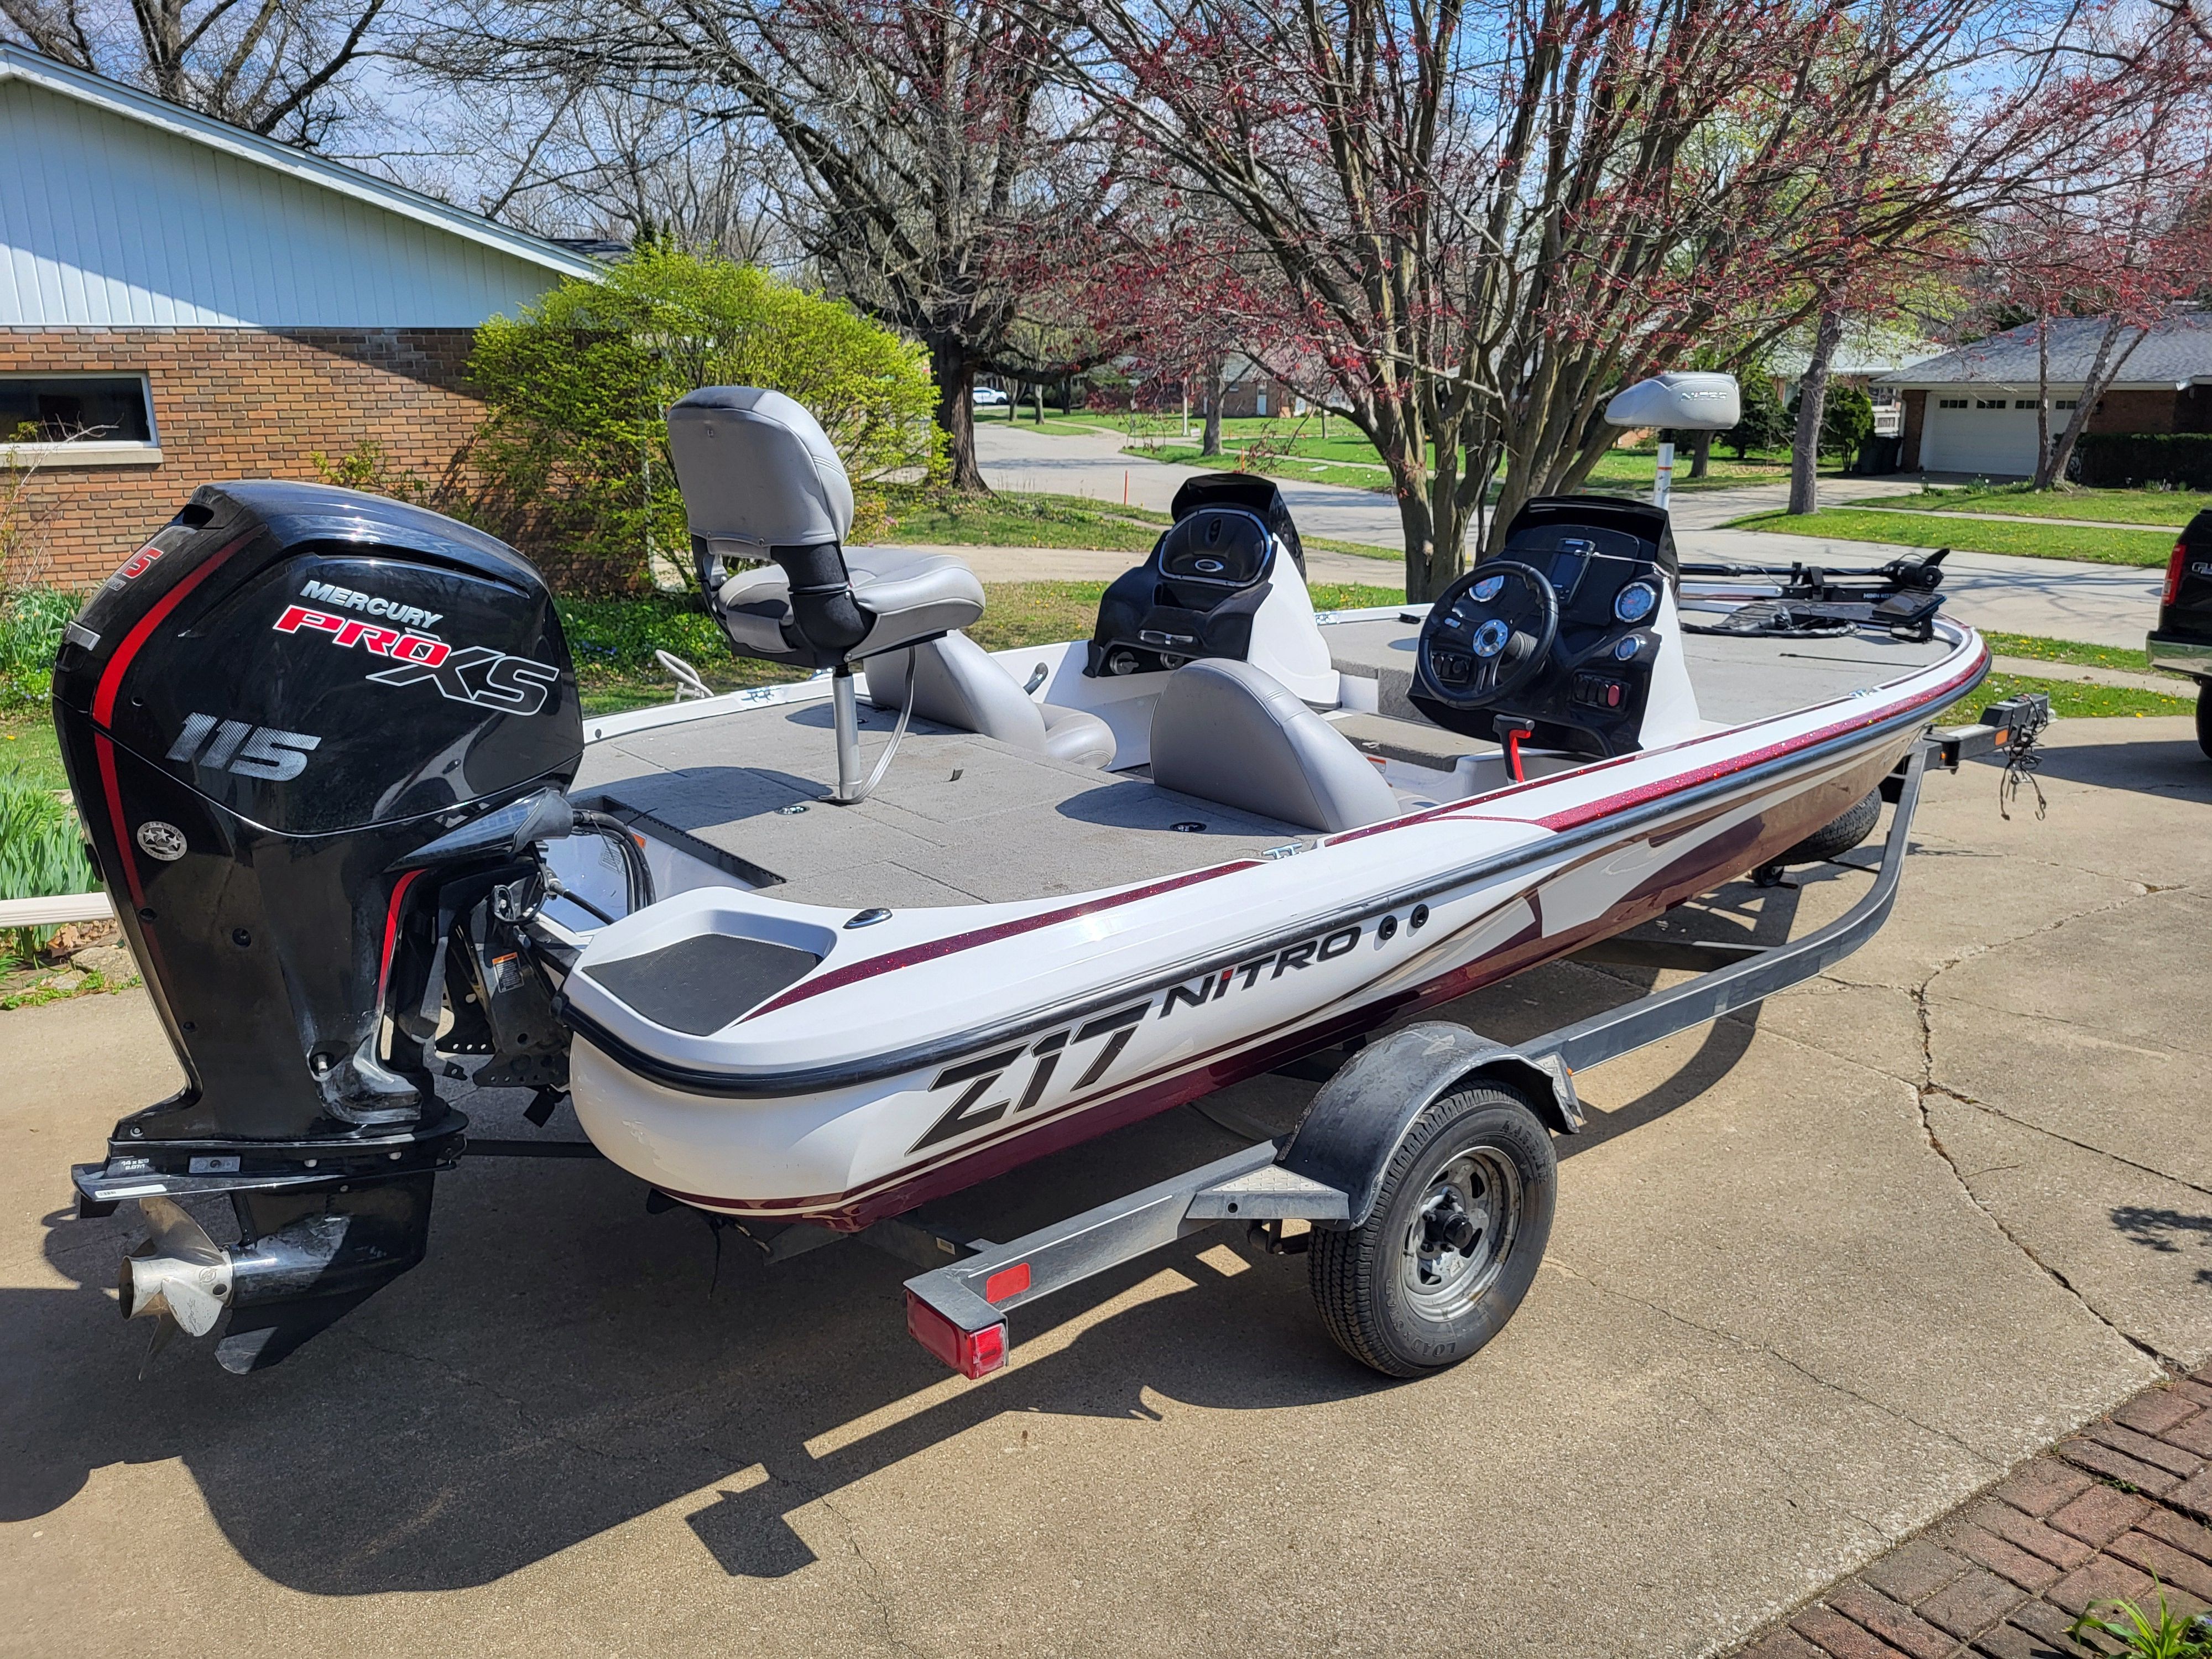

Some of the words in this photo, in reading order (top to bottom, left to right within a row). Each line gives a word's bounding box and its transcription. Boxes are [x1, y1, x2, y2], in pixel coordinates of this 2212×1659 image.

[299, 580, 444, 629] MERCURY
[273, 604, 451, 668] PRO
[366, 627, 560, 716] XS
[165, 712, 322, 781] 115
[904, 998, 1154, 1157] Z17
[1157, 925, 1361, 1020] NITRO
